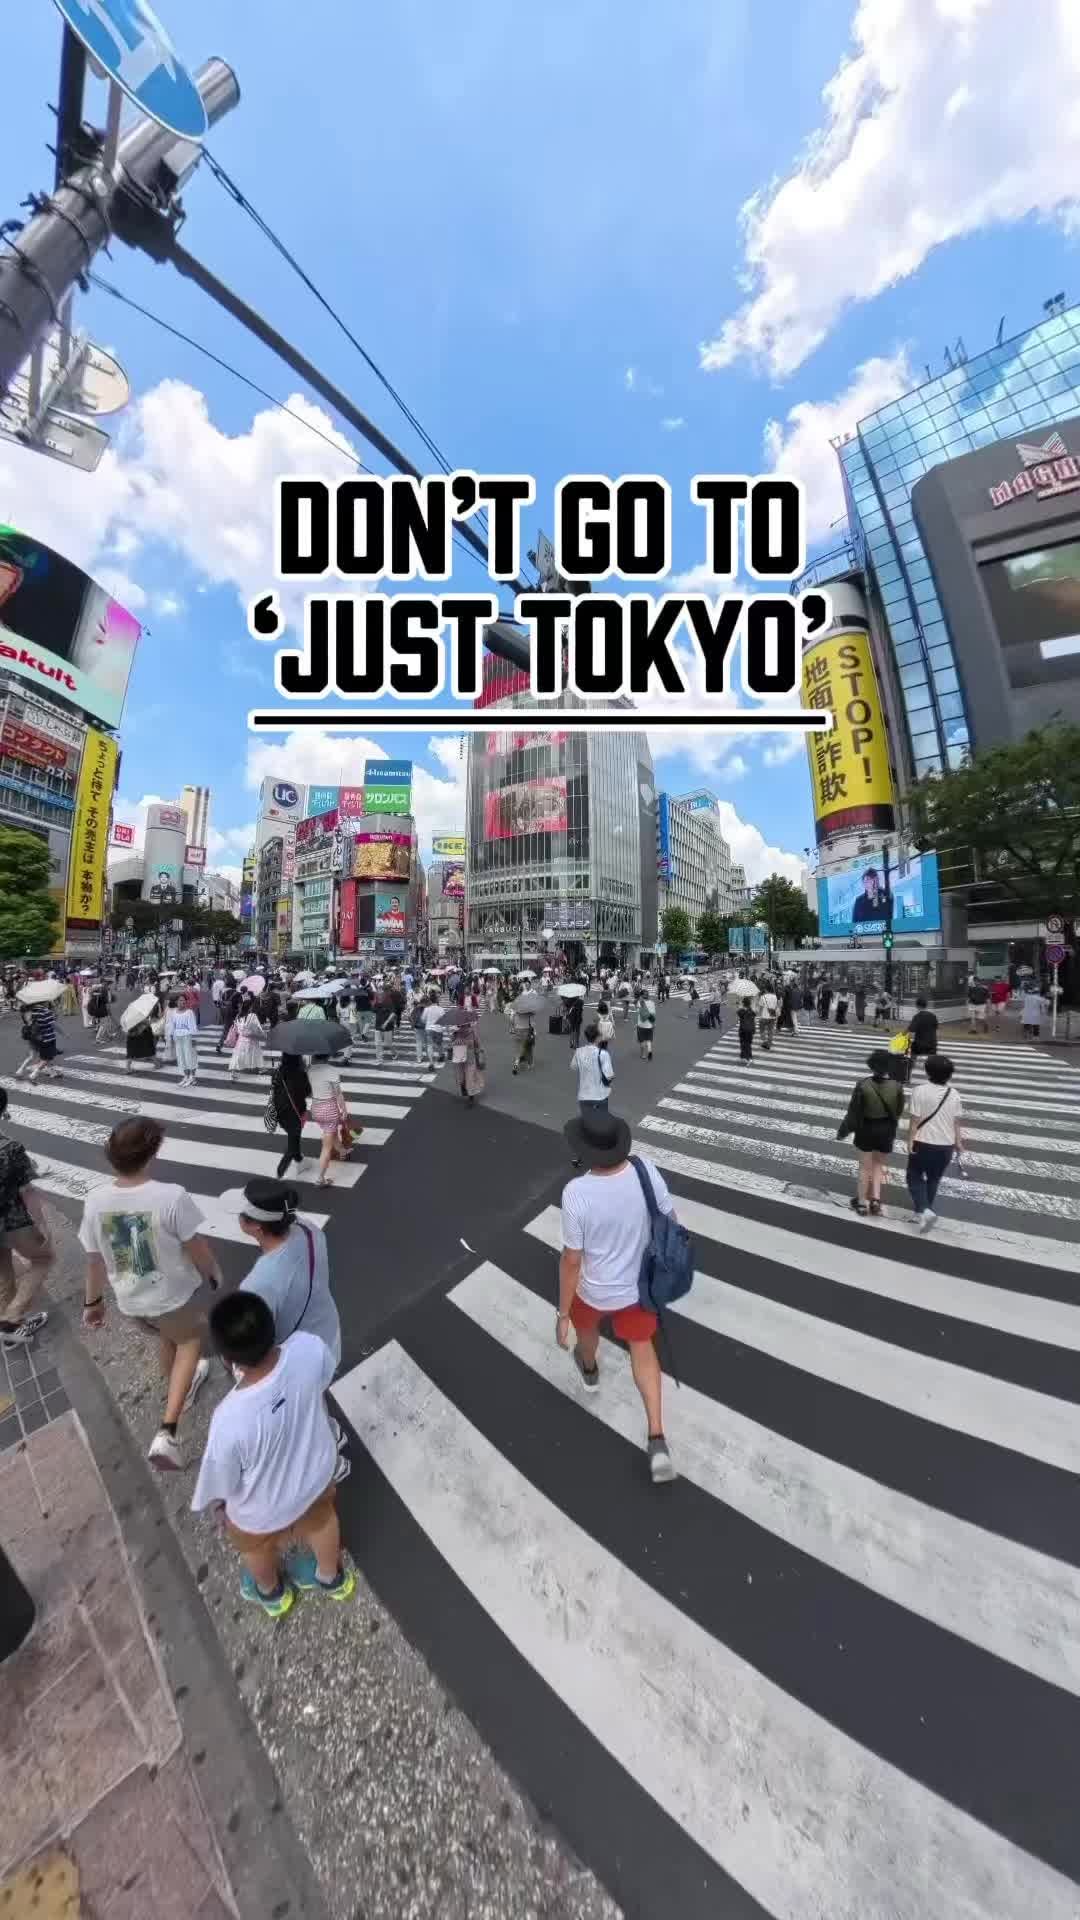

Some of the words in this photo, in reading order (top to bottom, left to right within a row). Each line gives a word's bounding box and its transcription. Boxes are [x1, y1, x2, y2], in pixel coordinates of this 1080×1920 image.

[989, 456, 1080, 506] MAGN
[0, 641, 77, 691] akult
[366, 793, 407, 804] サロンパス
